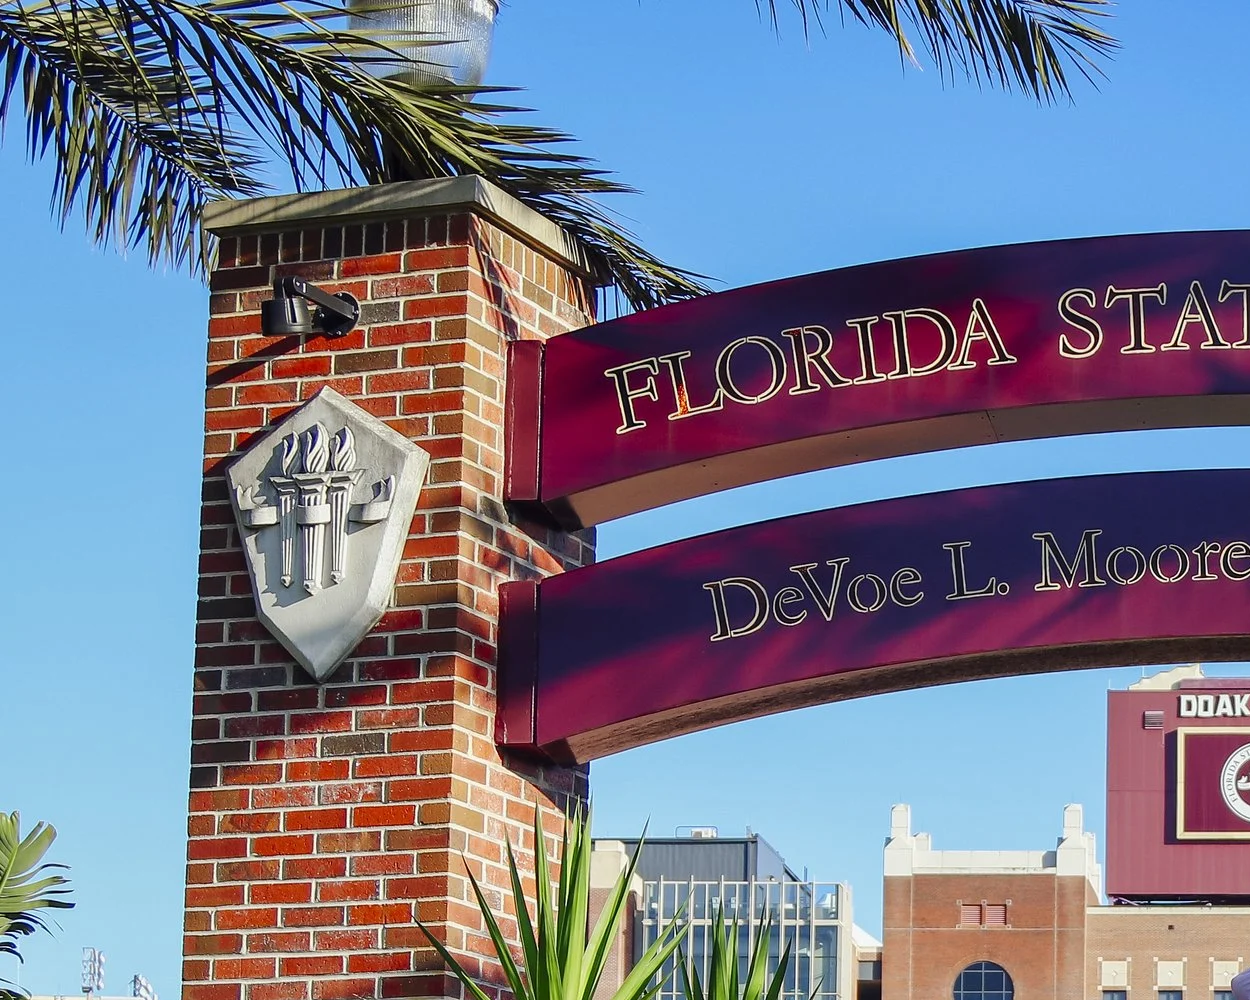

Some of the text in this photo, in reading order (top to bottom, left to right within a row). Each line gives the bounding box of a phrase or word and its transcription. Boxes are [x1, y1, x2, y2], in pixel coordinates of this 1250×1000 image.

[604, 297, 1017, 434] FLORIDA
[702, 556, 925, 642] DeVoe
[942, 541, 1010, 600] L.
[1225, 759, 1241, 803] FLORIDA
